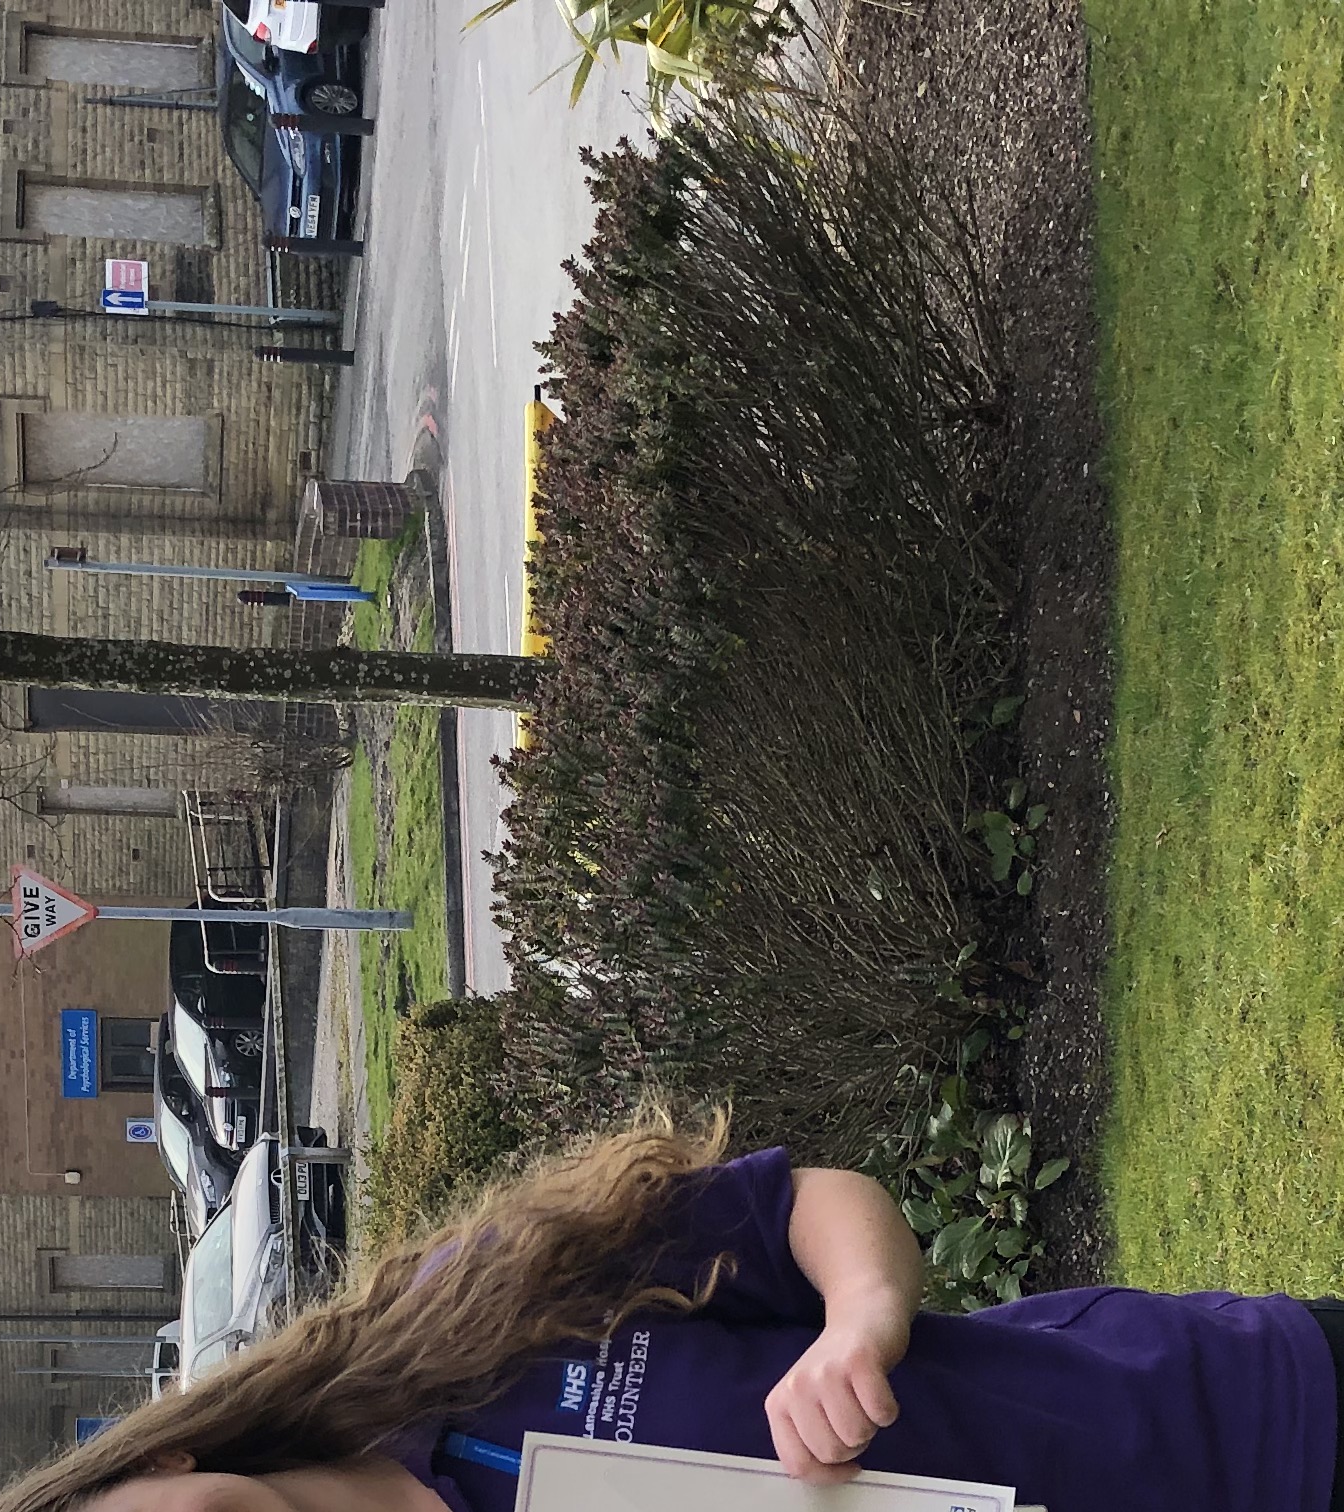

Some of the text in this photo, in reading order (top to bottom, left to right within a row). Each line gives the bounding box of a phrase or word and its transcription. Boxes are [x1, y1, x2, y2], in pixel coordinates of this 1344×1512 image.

[23, 887, 40, 938] GIVE
[45, 896, 56, 926] WAY
[67, 1028, 78, 1080] Department of
[80, 1016, 92, 1092] Psychological Services
[298, 1162, 306, 1173] PU
[560, 1364, 586, 1410] NHS
[583, 1370, 605, 1439] Lancashire
[600, 1362, 624, 1422] NHS Trust
[615, 1330, 650, 1443] OLUNTEER
